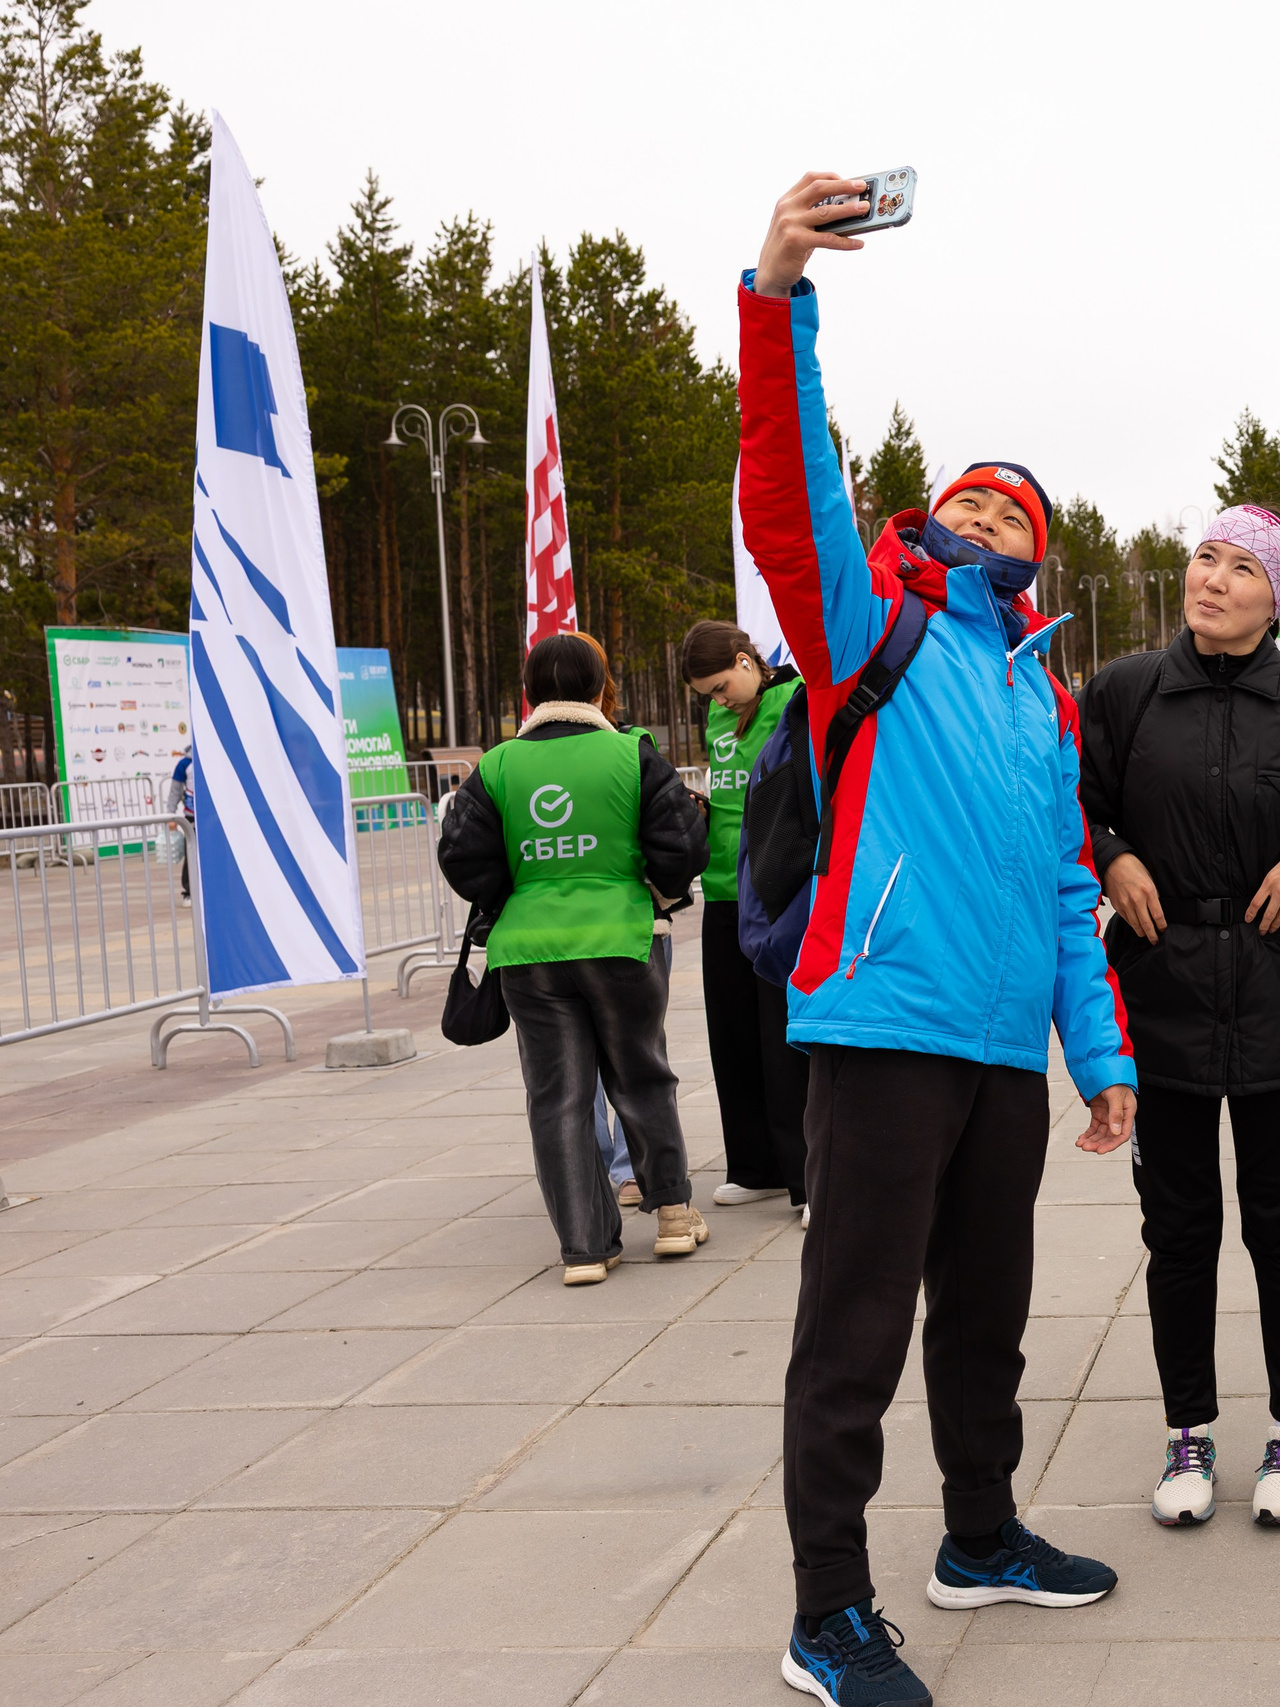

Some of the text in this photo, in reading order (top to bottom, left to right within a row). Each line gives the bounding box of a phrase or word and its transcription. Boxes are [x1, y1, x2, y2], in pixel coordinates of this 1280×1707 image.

[345, 733, 392, 754] ОМОГАЙ
[347, 751, 403, 773] ОХНОВЛЯЙ
[711, 769, 750, 790] БЕР
[520, 834, 598, 861] СБЕР
